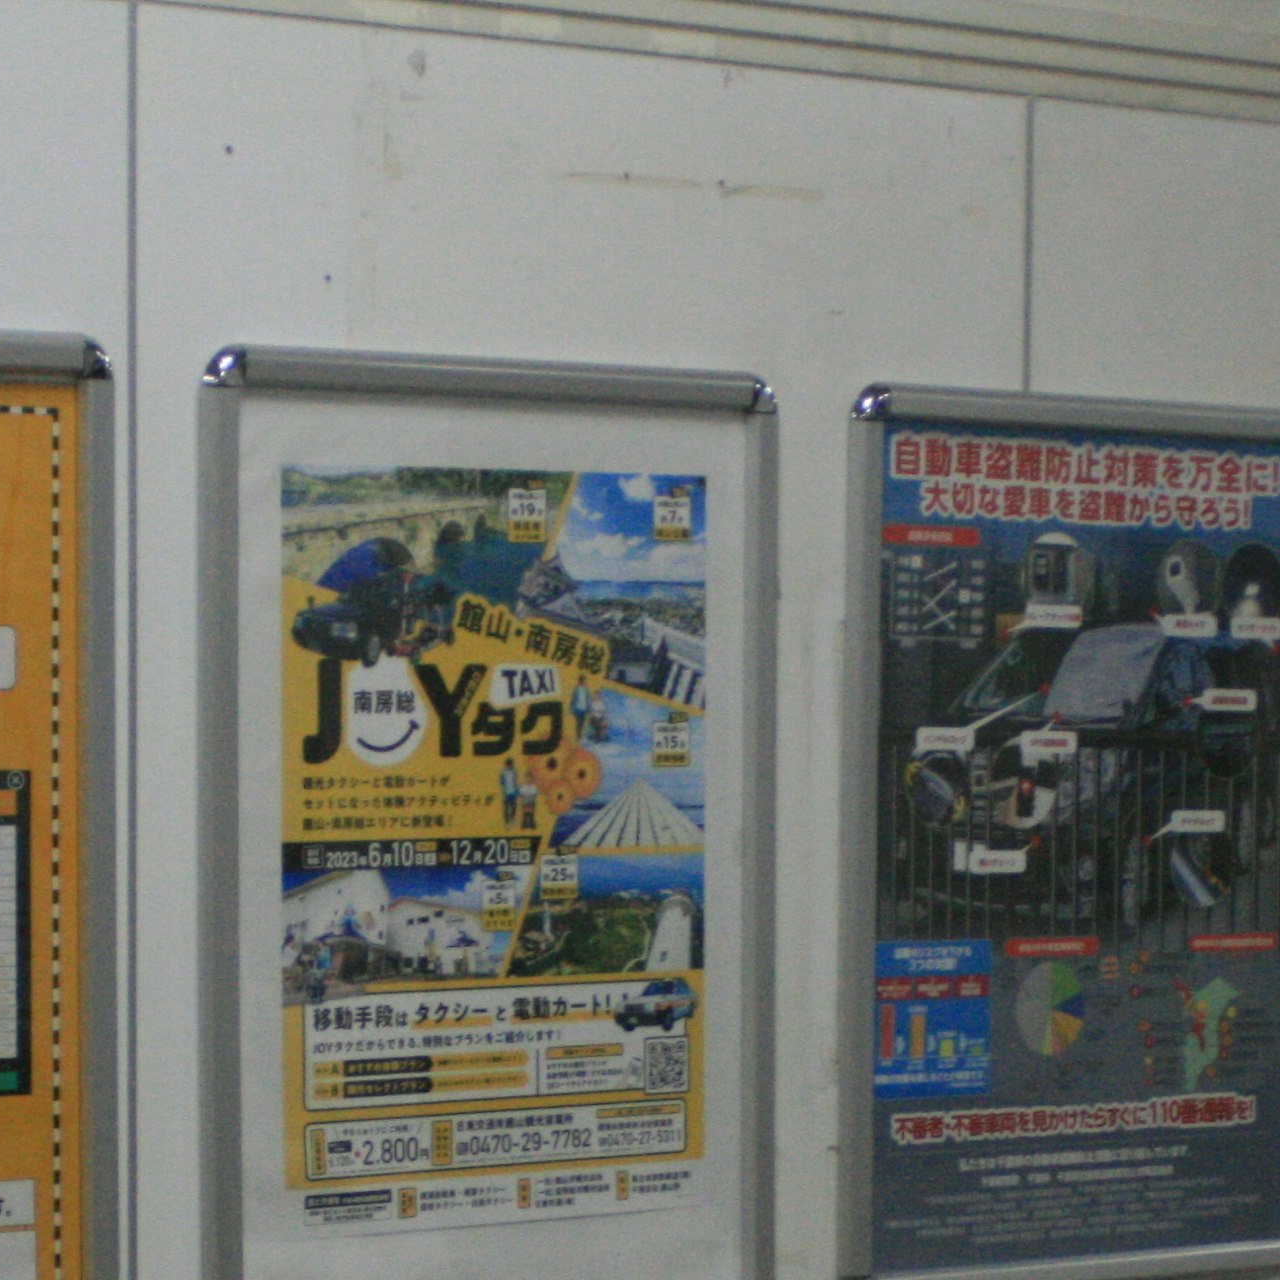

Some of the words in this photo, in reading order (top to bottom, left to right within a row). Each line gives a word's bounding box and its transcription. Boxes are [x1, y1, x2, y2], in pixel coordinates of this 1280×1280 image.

[457, 599, 606, 676] 館山・南房総
[501, 666, 555, 699] TAXI
[353, 690, 416, 715] 南房総
